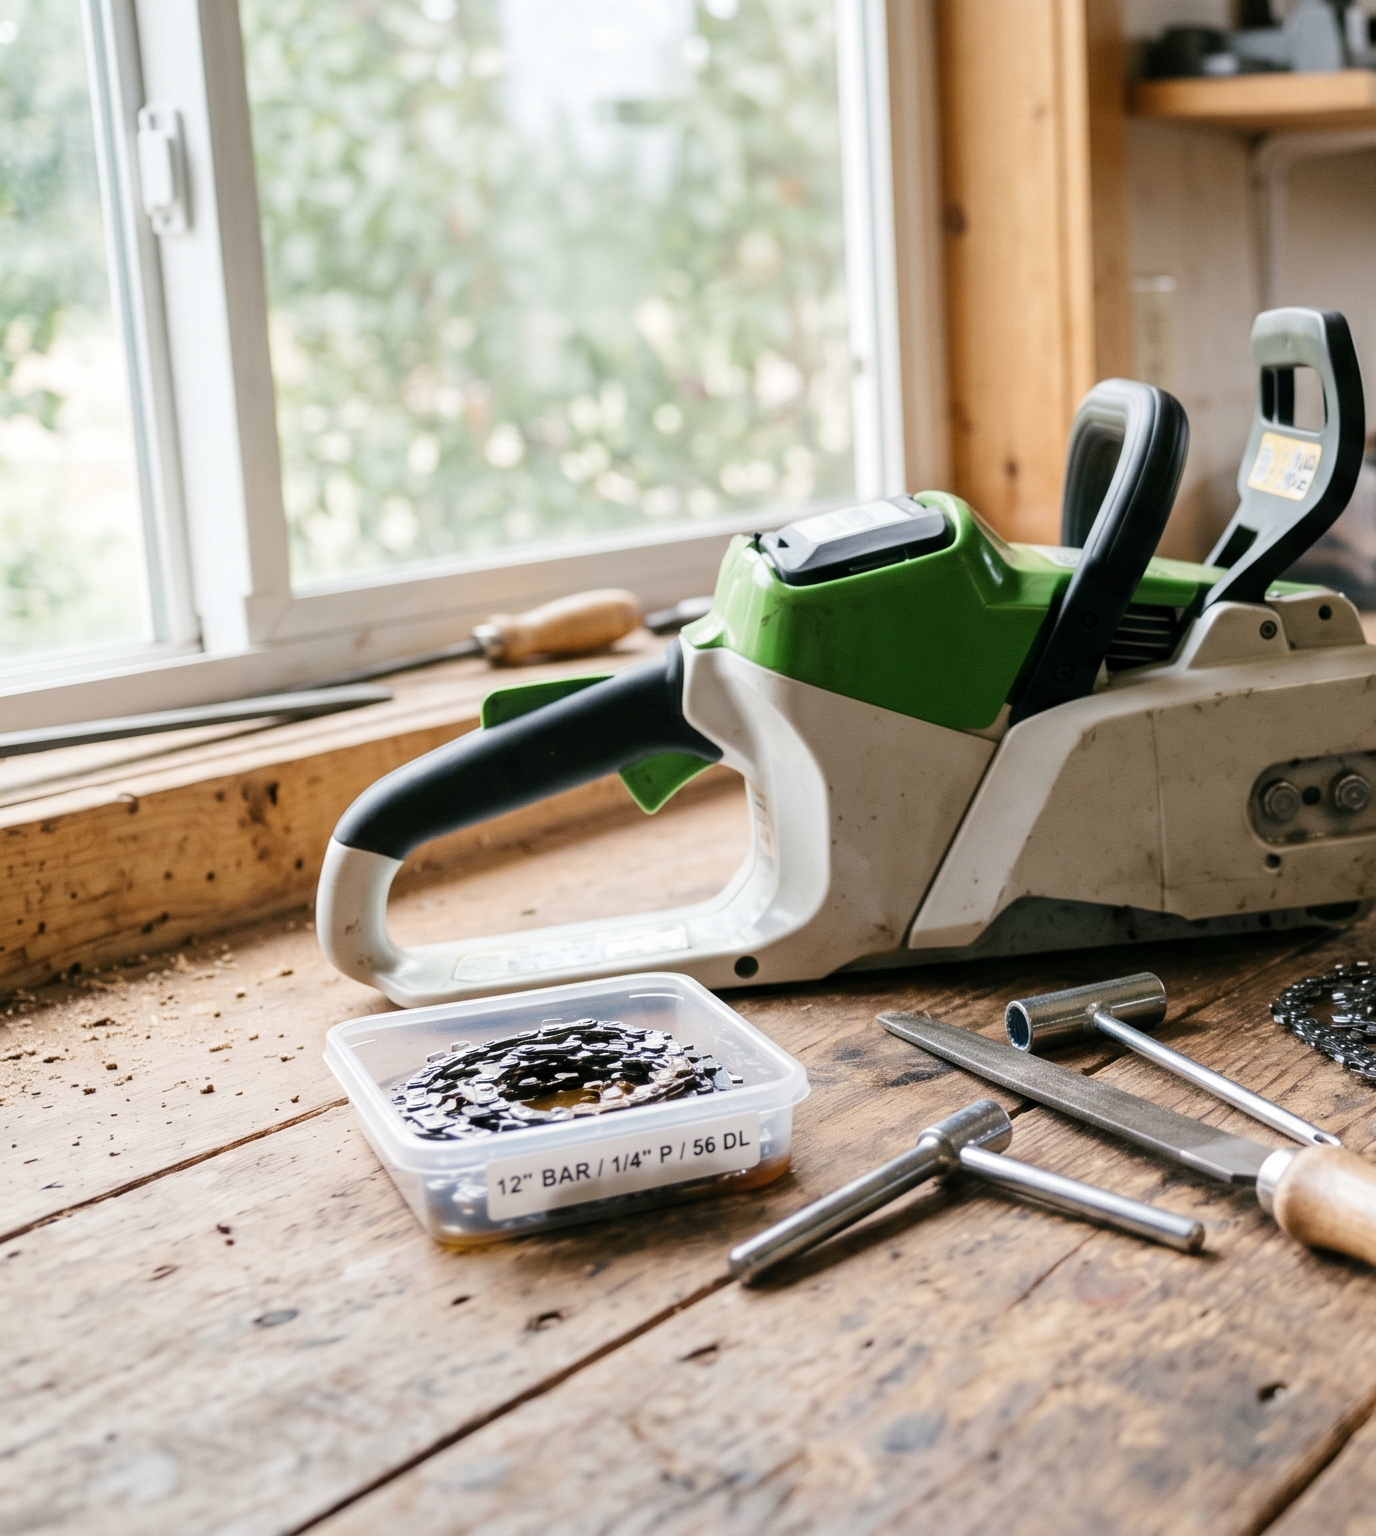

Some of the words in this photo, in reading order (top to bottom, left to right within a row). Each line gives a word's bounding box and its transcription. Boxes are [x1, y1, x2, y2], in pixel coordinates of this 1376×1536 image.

[497, 1173, 533, 1196] 12"
[542, 1162, 591, 1188] BAR
[597, 1158, 604, 1177] /
[611, 1149, 651, 1173] 1/4"
[660, 1145, 673, 1163] P
[679, 1141, 686, 1160] /
[693, 1136, 716, 1157] 56
[723, 1130, 750, 1151] DL
